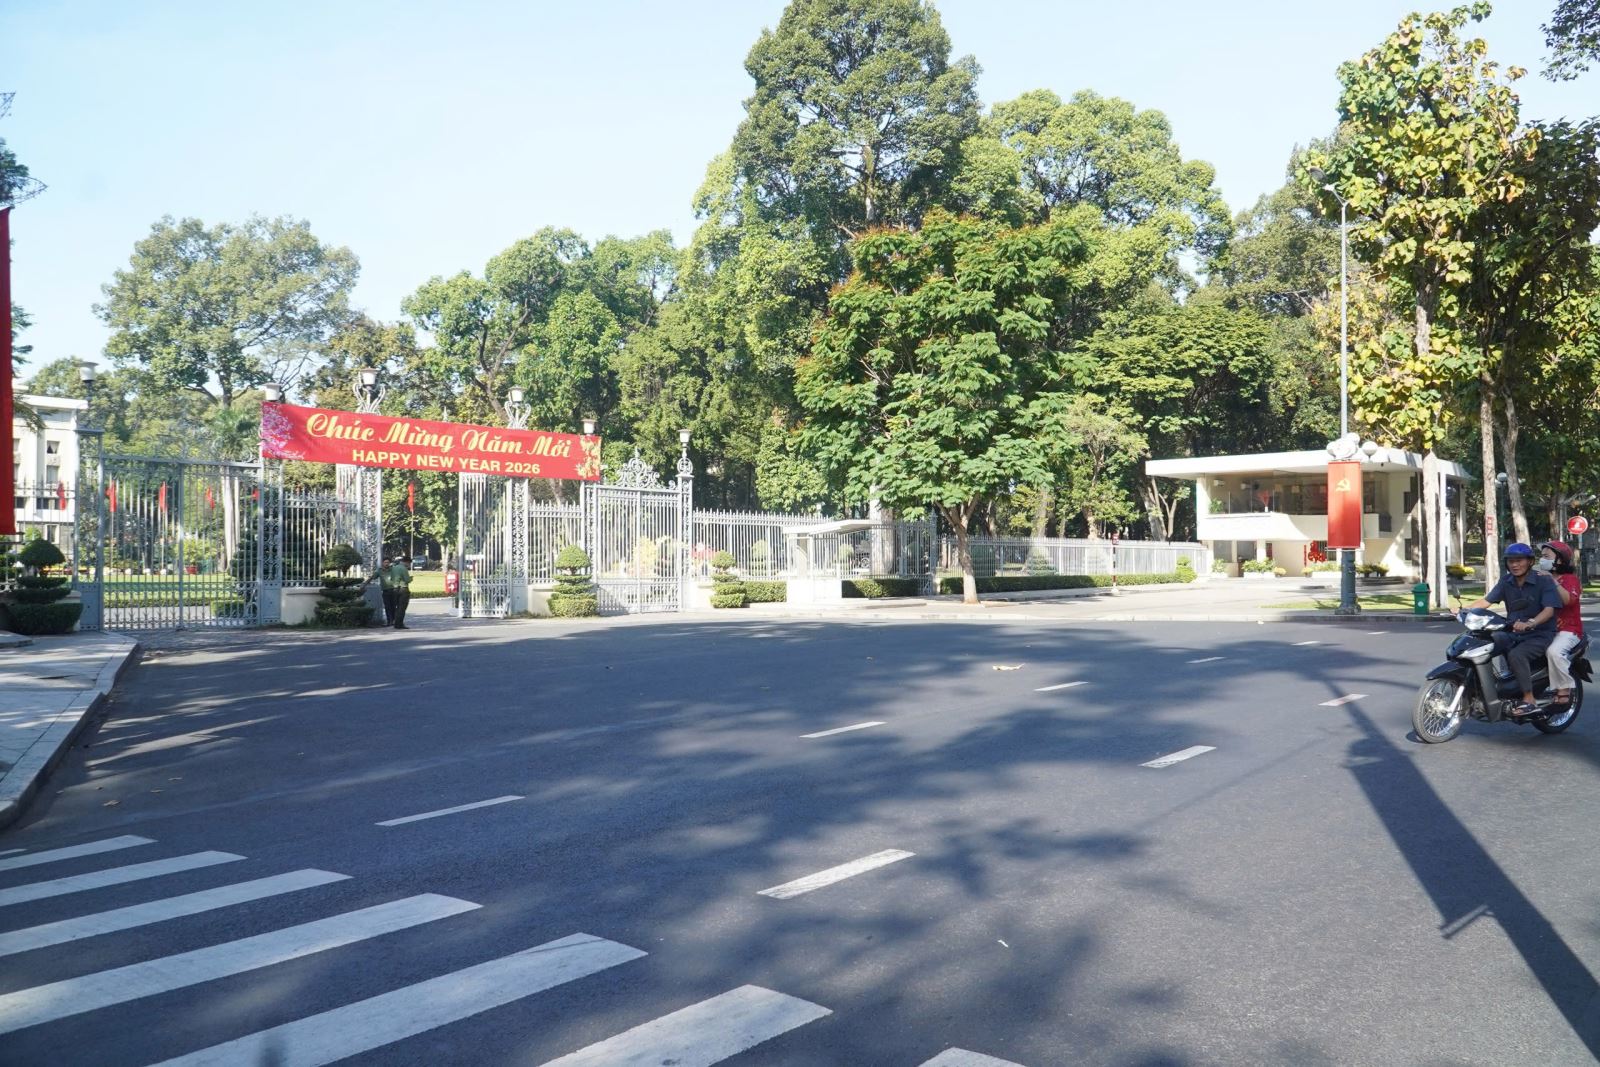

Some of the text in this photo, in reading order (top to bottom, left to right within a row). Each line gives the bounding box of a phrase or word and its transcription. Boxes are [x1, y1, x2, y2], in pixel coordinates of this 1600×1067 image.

[306, 413, 572, 458] Chúc Mừng Năm Mới
[352, 449, 541, 475] HAPPY NEW YEAR 2026
